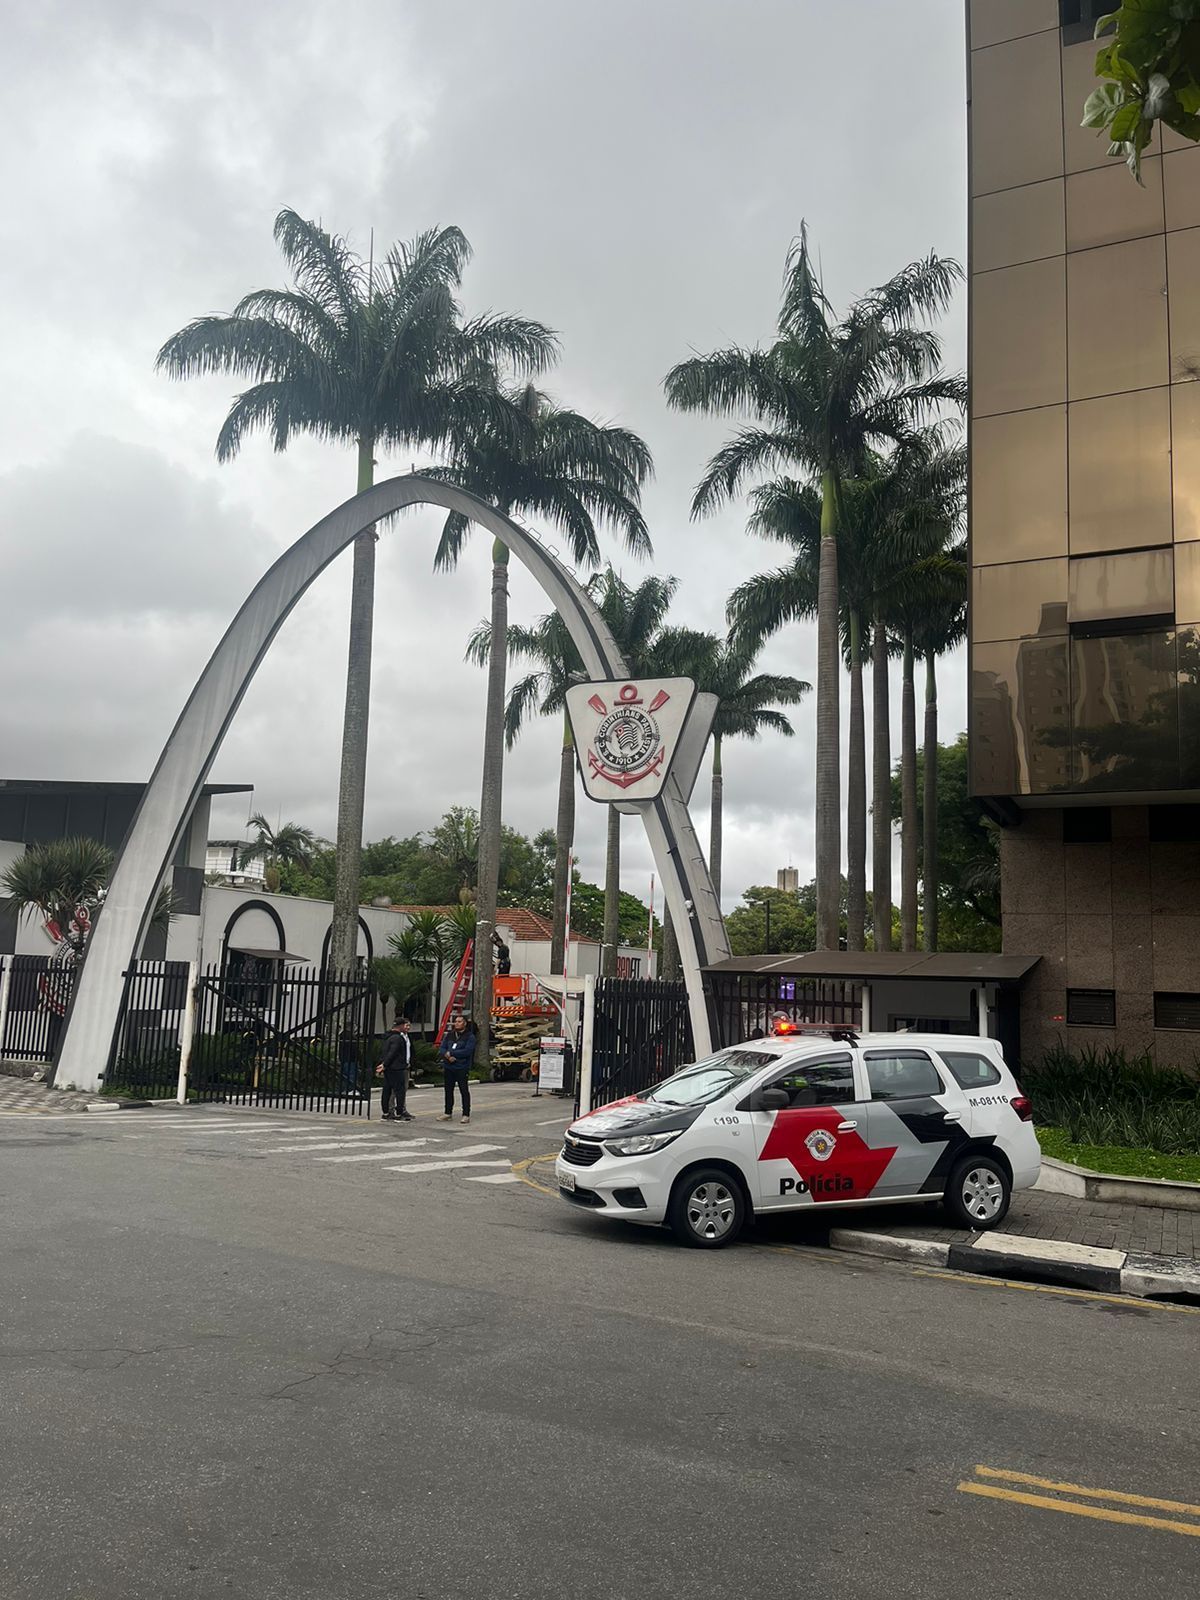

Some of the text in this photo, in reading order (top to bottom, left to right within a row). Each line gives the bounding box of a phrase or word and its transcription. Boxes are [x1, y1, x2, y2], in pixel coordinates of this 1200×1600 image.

[600, 710, 641, 737] CORINTHIANS
[640, 717, 652, 753] PAULISTA
[969, 1096, 1009, 1107] M-08116
[719, 1116, 739, 1125] 190
[779, 1173, 854, 1195] Polícia
